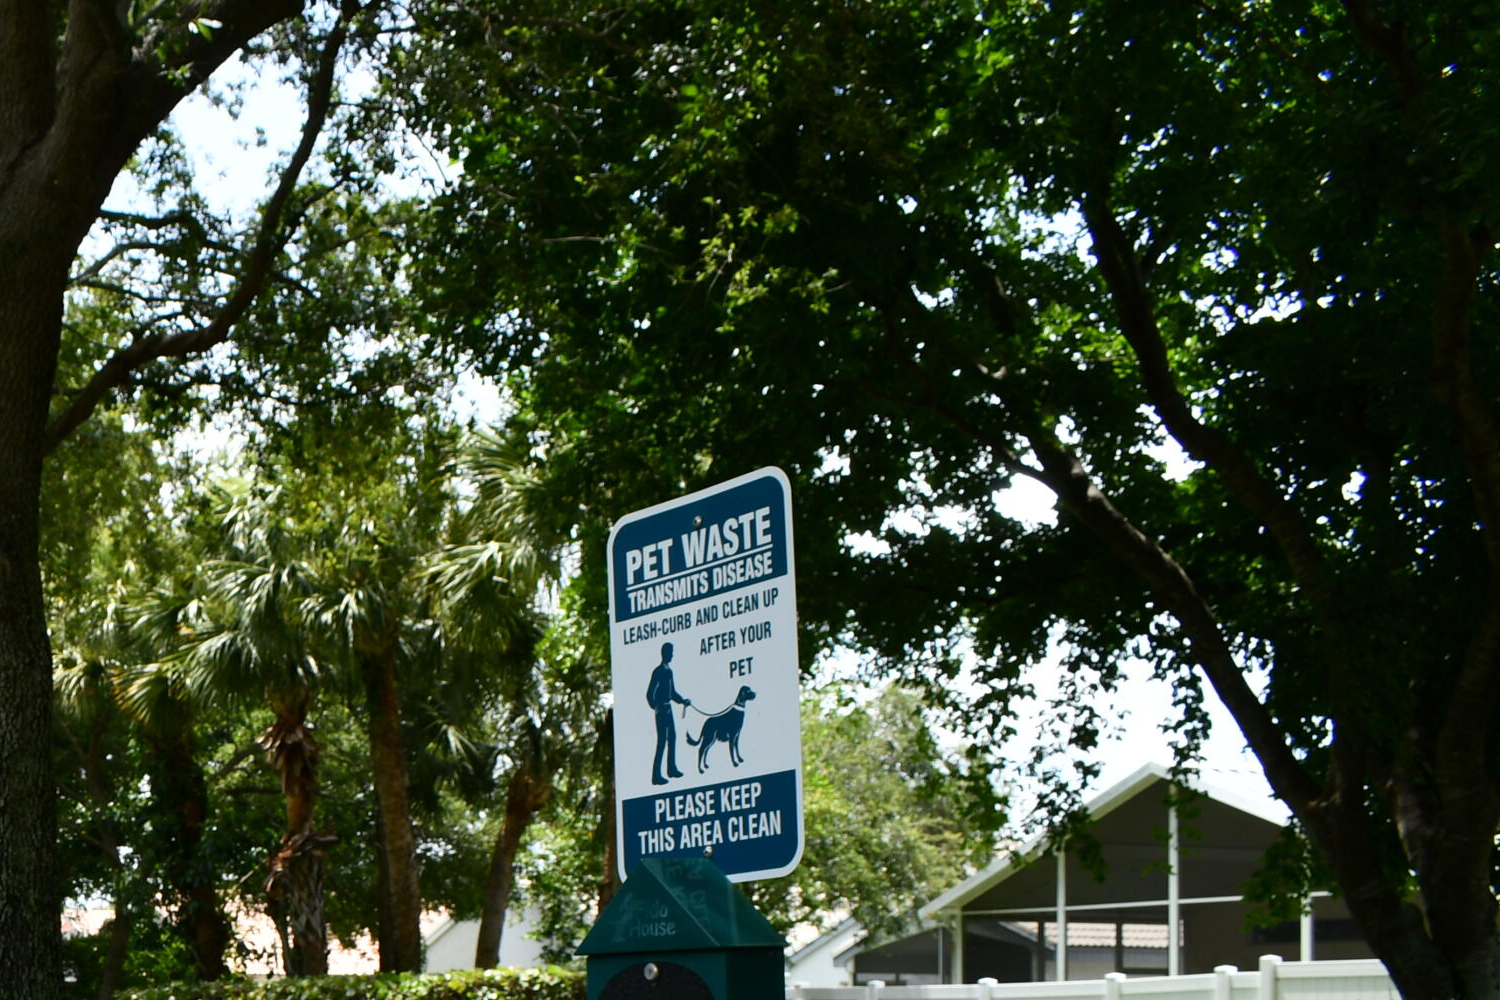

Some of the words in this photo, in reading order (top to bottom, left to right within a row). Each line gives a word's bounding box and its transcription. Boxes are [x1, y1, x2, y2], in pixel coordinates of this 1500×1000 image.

[626, 538, 673, 586] PET
[681, 506, 772, 568] WASTE
[628, 570, 708, 614] TRANSMITS
[712, 551, 773, 591] DISEASE
[623, 612, 692, 645] LEASH-CURB
[695, 605, 718, 626] AND
[722, 592, 759, 619] CLEAN
[762, 587, 779, 607] UP
[699, 630, 736, 656] AFTER
[739, 621, 772, 645] YOUR
[729, 656, 754, 679] PET
[655, 790, 715, 823] PLEASE
[720, 782, 761, 813] KEEP
[638, 826, 675, 855] THIS
[680, 819, 723, 849] AREA
[728, 810, 781, 842] CLEAN
[628, 918, 676, 937] House
